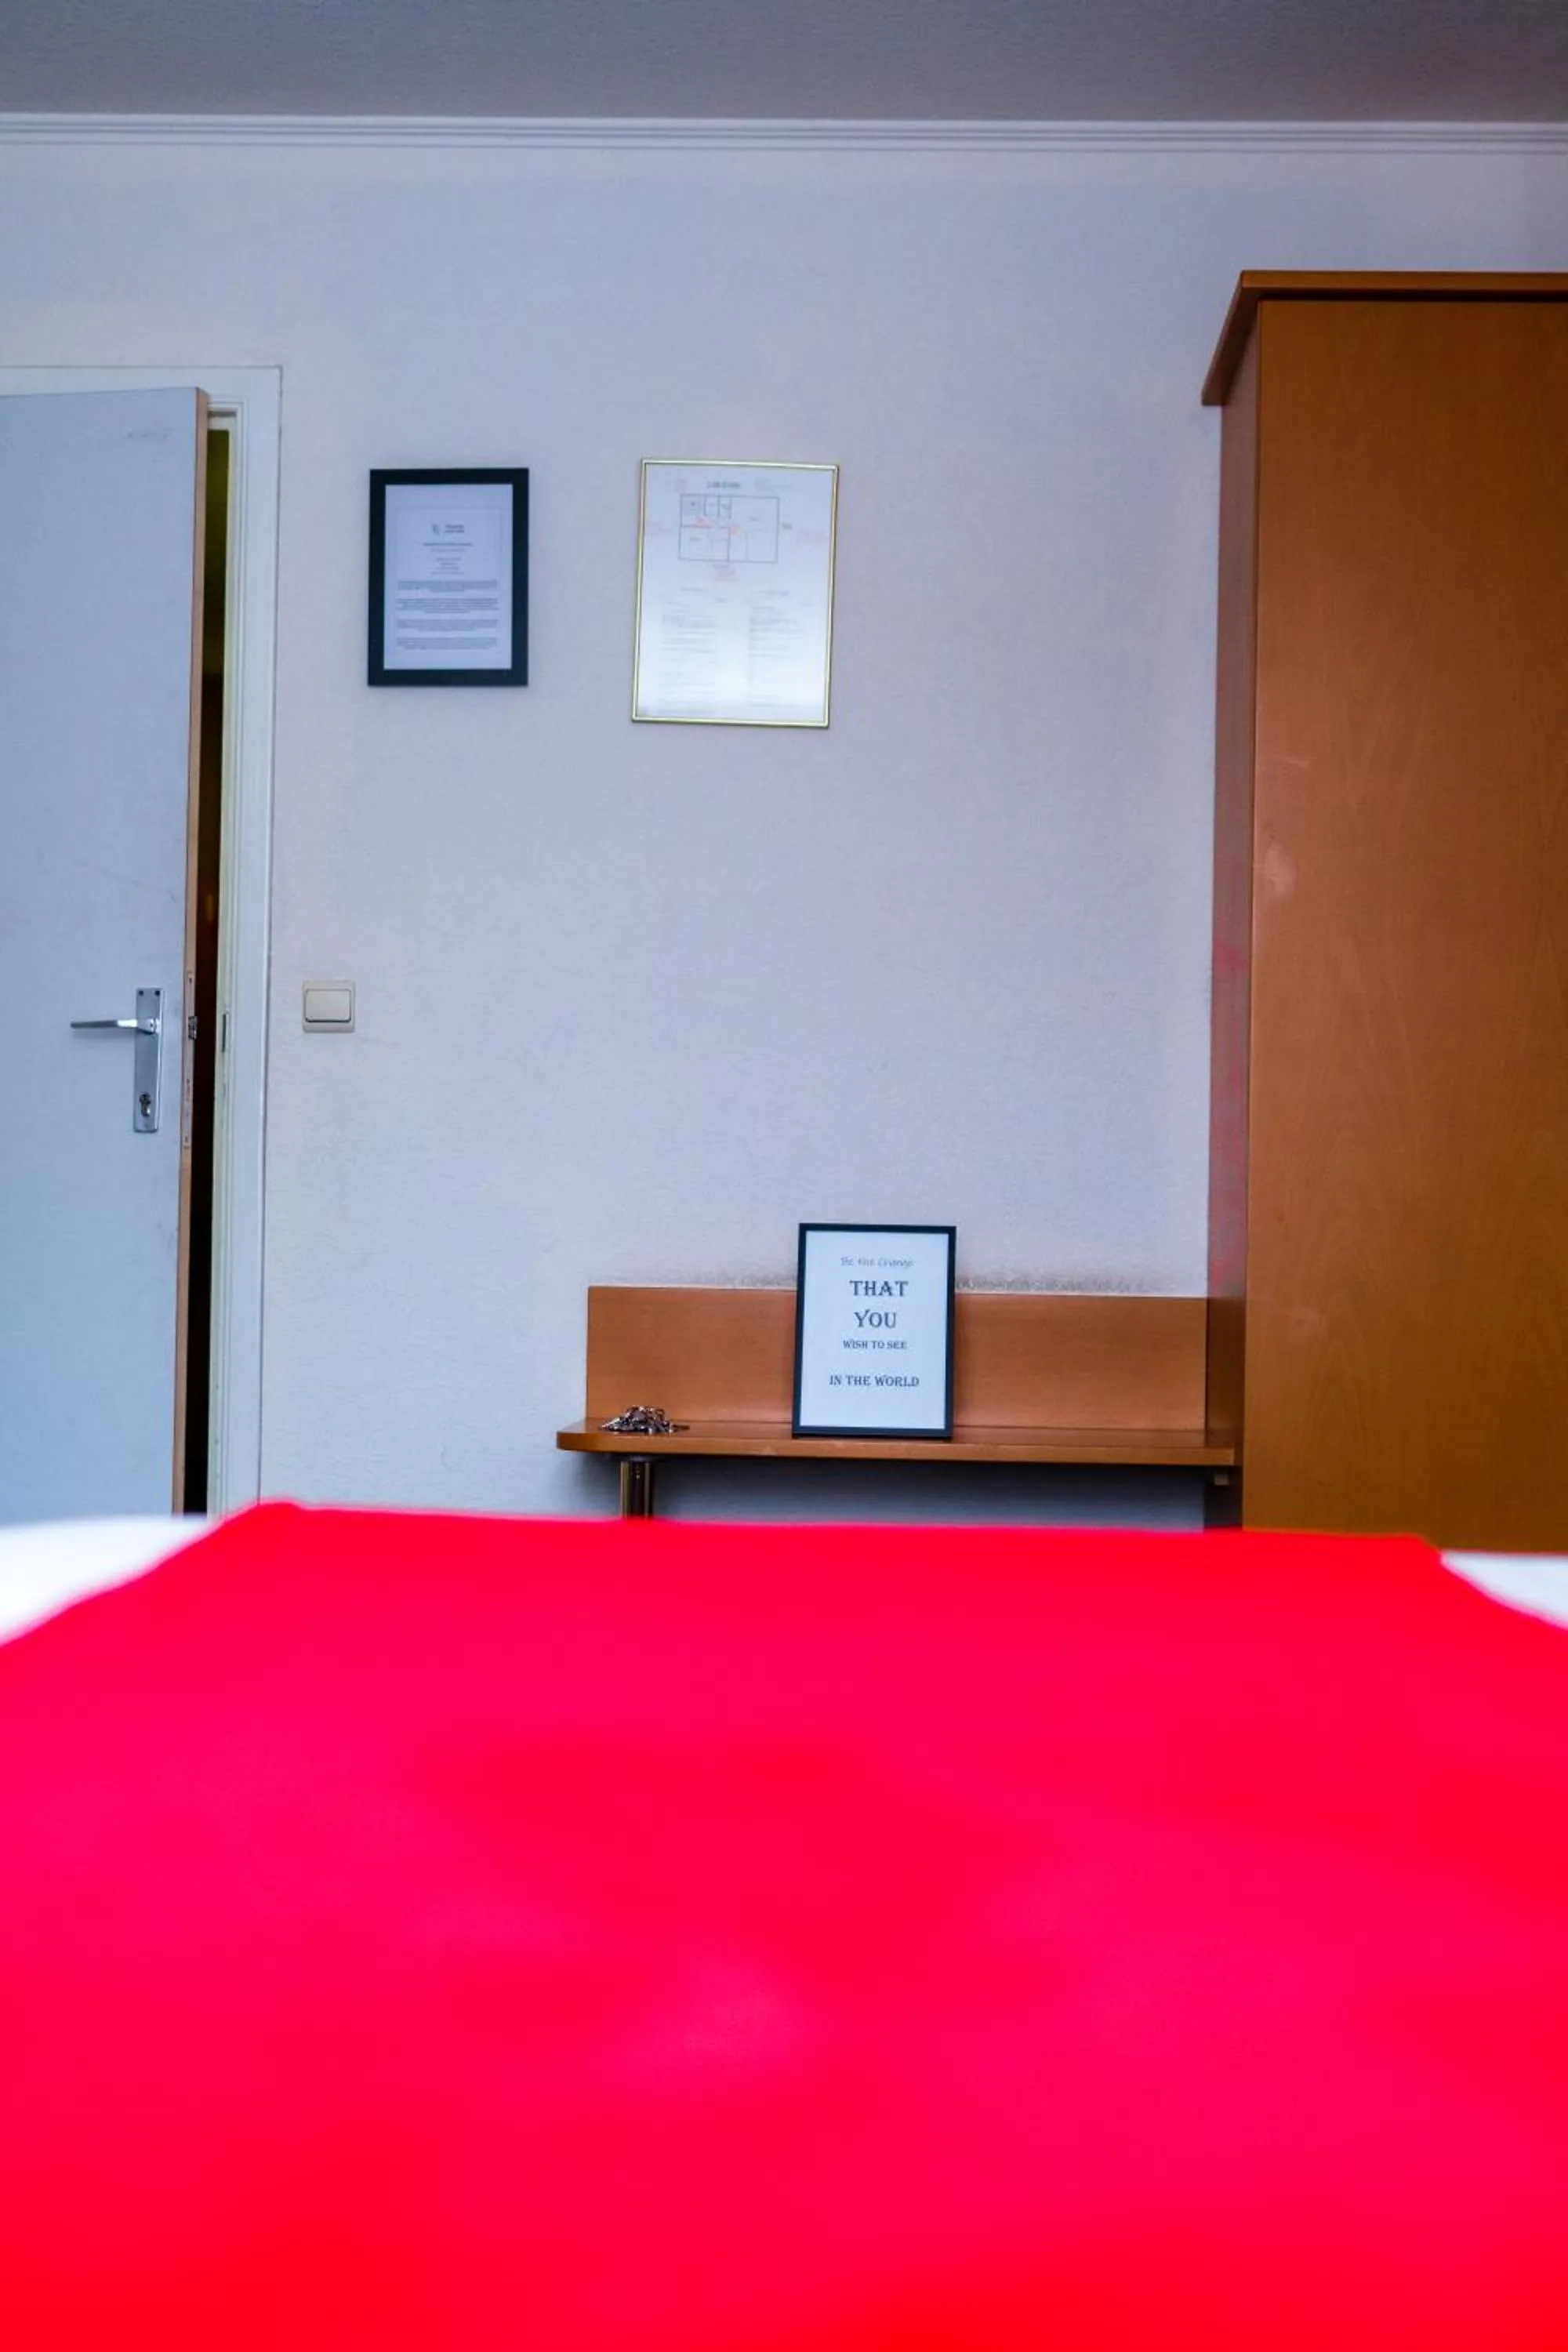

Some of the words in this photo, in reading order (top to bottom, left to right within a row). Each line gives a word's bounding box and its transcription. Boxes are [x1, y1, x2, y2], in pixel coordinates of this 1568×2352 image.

[849, 1280, 909, 1296] THAT
[854, 1308, 896, 1328] YOU
[843, 1339, 868, 1349] WISH
[871, 1340, 885, 1349] TO
[887, 1341, 907, 1349] SEE
[829, 1374, 841, 1385] IN
[845, 1375, 871, 1386] THE
[874, 1375, 920, 1387] WORLD
